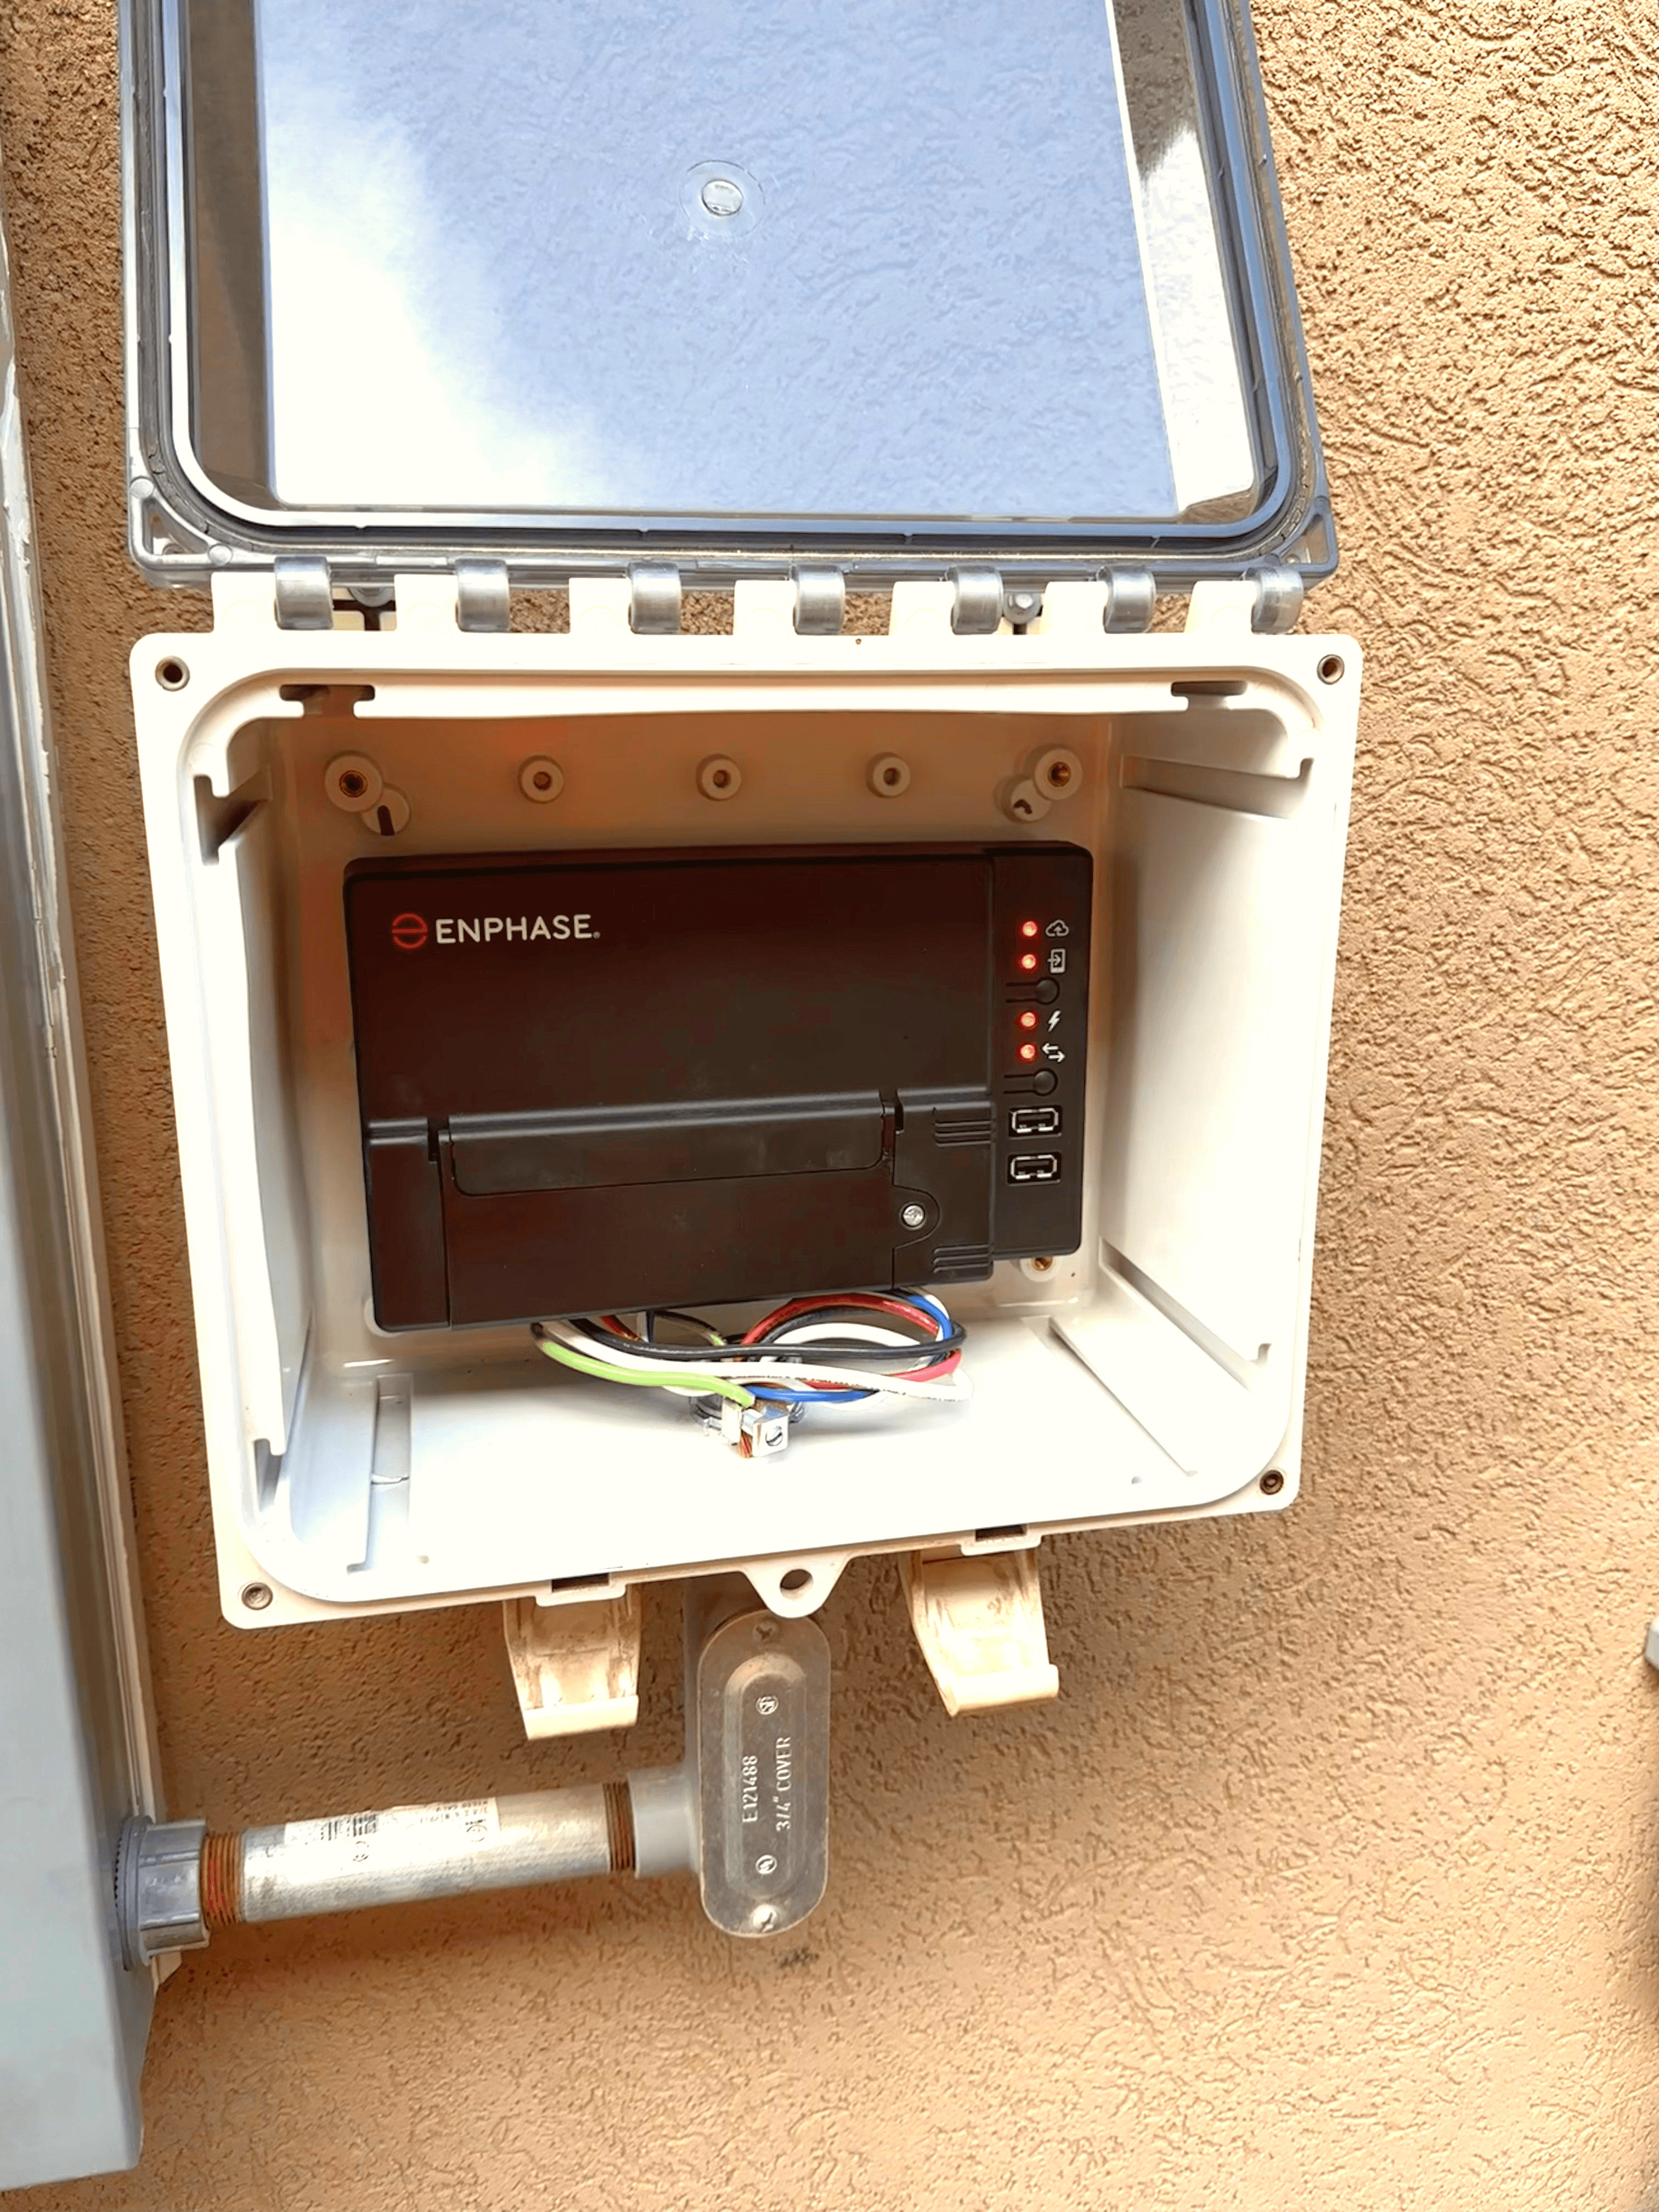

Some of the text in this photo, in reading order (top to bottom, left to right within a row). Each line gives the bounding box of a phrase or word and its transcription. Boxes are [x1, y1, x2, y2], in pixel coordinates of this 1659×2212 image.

[436, 913, 592, 944] ENPHASE
[742, 1755, 758, 1823] E121488
[772, 1736, 792, 1832] 3/4" COVER
